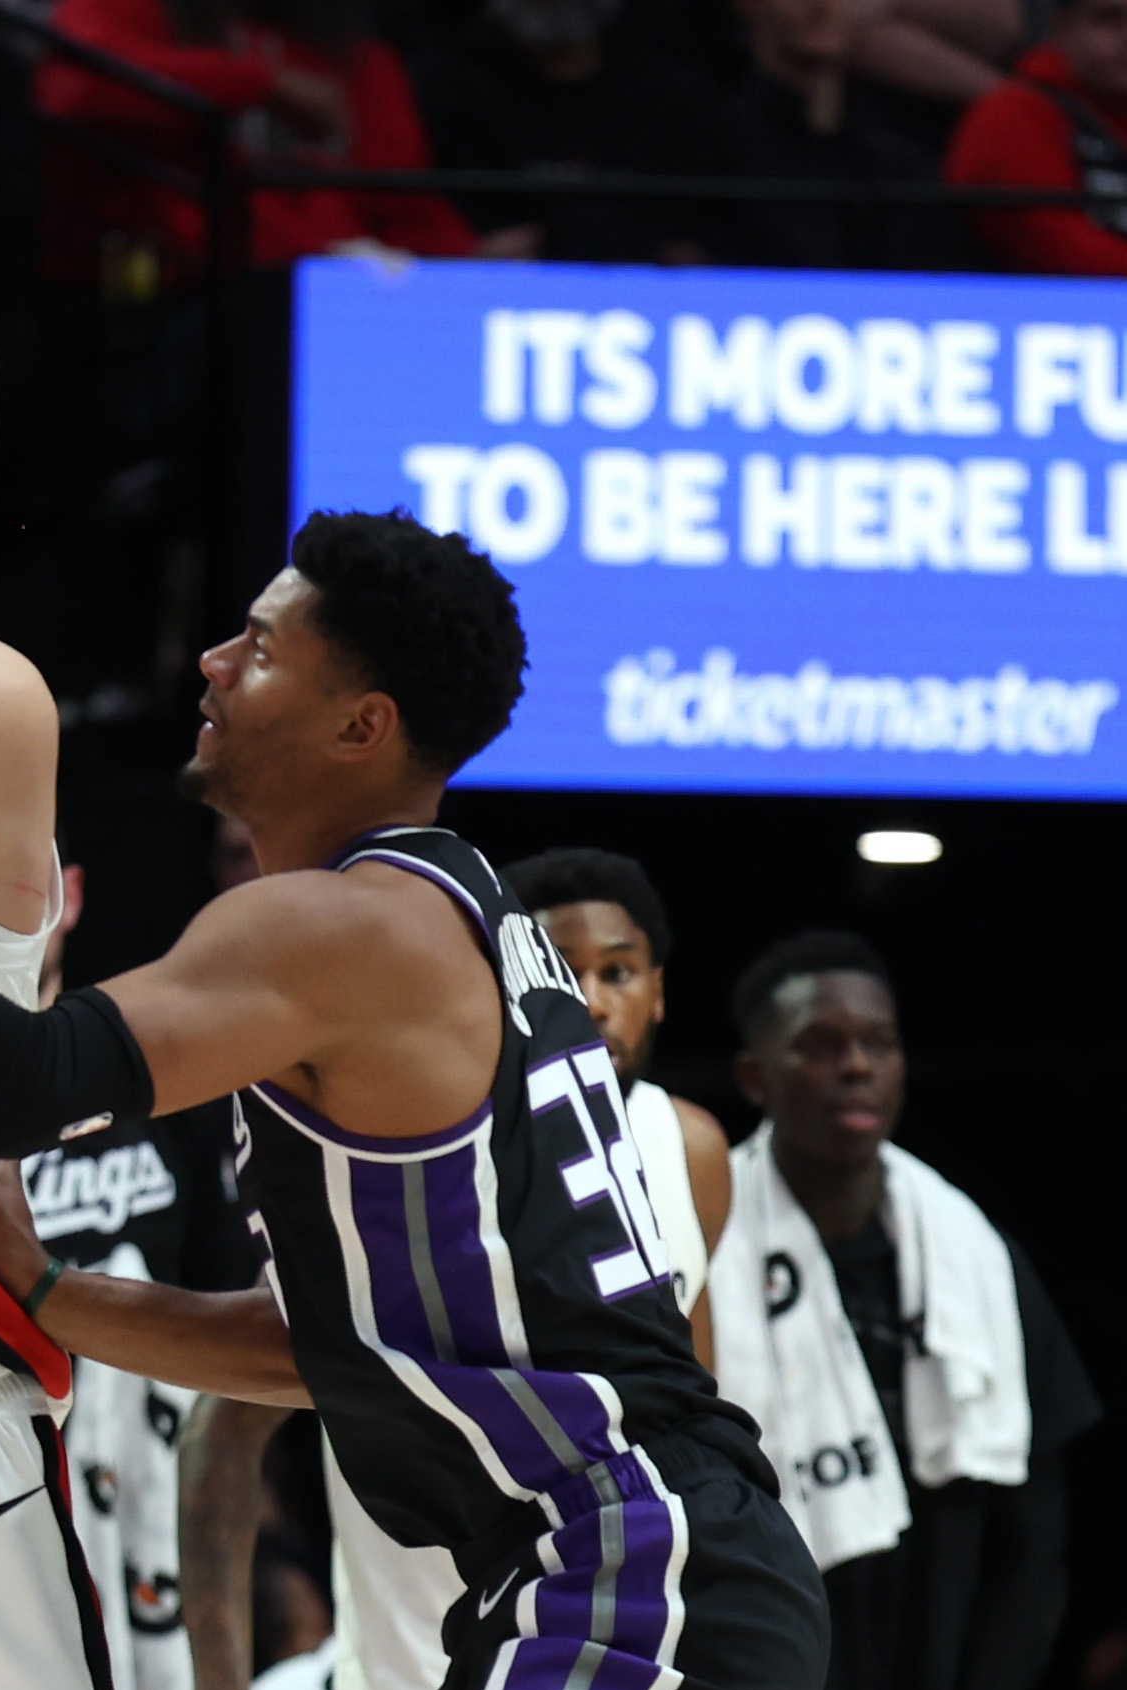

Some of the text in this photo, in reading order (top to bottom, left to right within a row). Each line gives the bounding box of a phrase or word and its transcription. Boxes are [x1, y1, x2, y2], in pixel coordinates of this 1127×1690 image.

[483, 308, 657, 430] ITS
[670, 313, 1001, 437] MORE
[403, 443, 569, 565] TO
[581, 448, 729, 567] BE
[740, 455, 1032, 573] HERE
[604, 647, 1119, 754] ticketmaster
